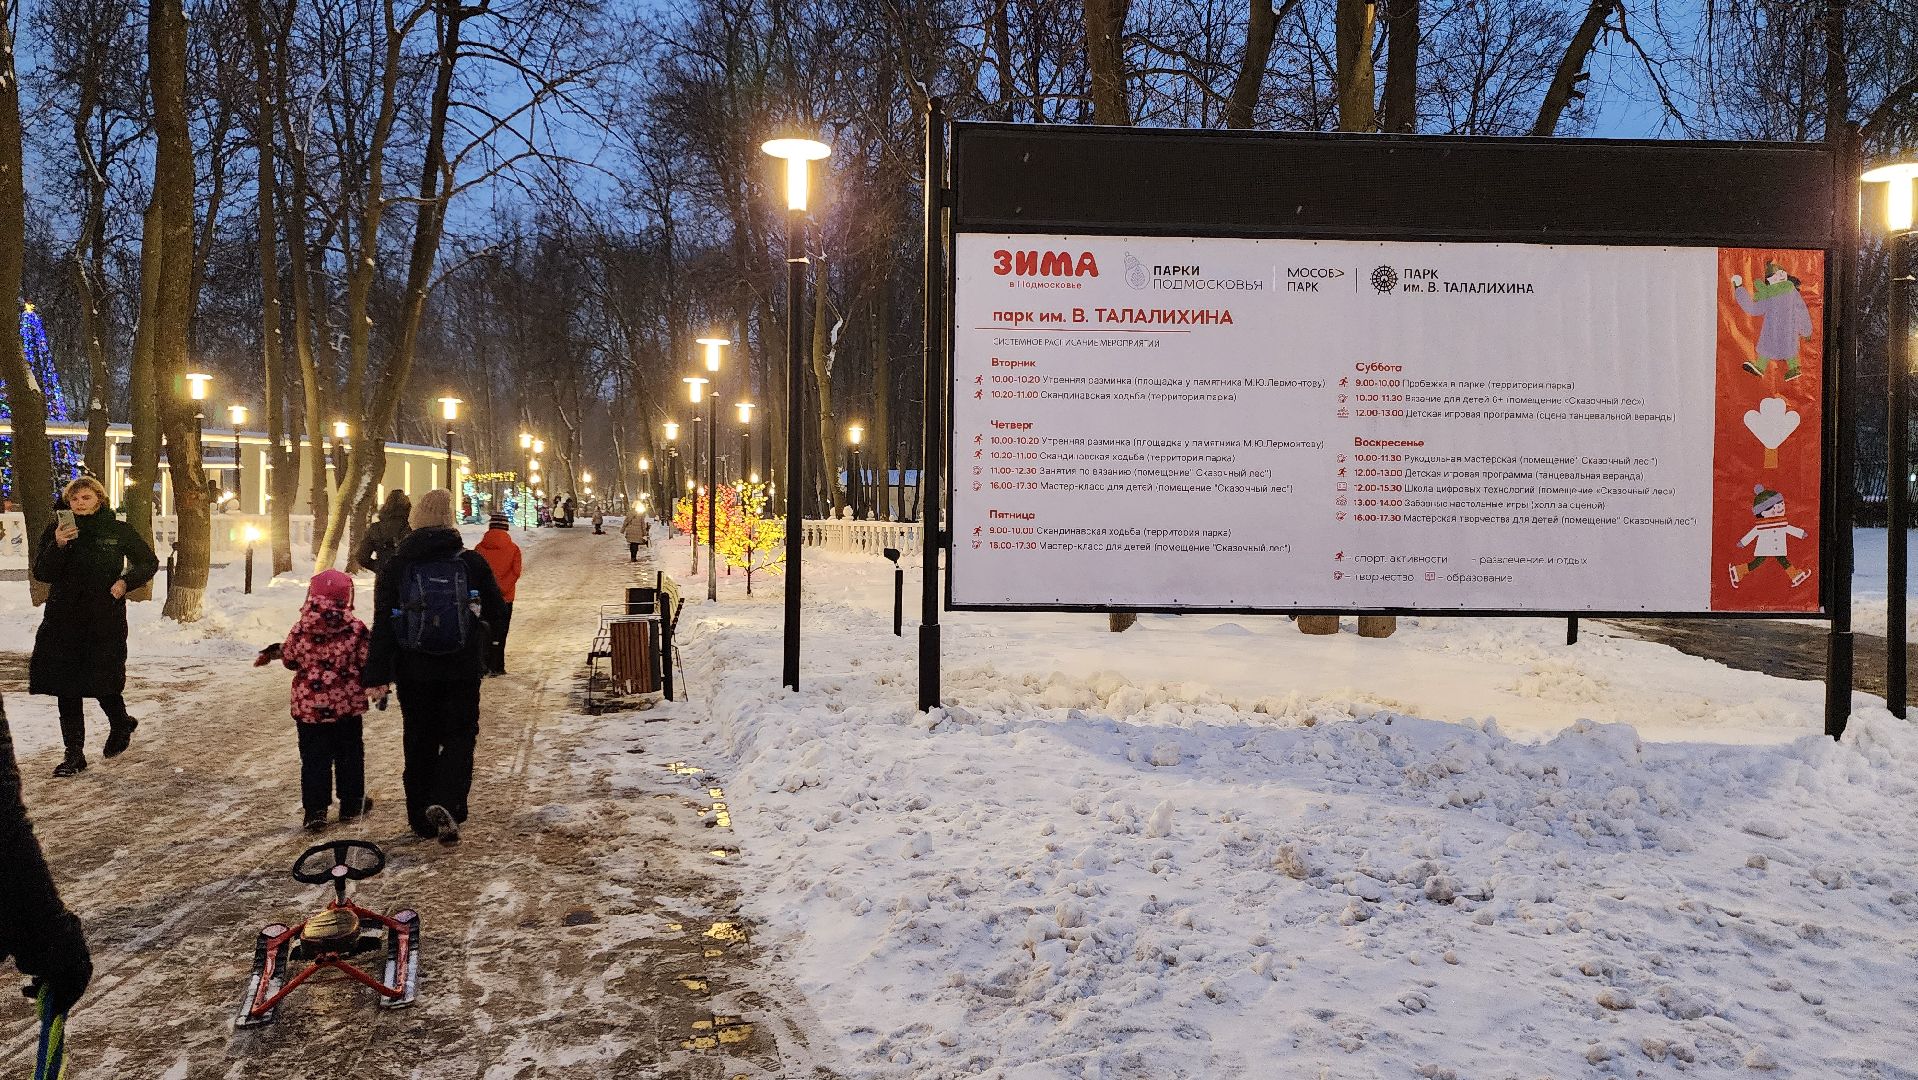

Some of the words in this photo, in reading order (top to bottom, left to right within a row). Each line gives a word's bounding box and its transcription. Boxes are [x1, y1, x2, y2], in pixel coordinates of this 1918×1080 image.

[993, 249, 1099, 277] ЗИМА
[1153, 265, 1200, 276] ПАРКИ
[1404, 269, 1438, 279] ПАРК
[1017, 281, 1082, 289] Подмосковье
[1153, 279, 1263, 291] ПОДМОСКОВЬЯ
[1287, 282, 1318, 292] ПАРК
[1404, 284, 1423, 292] им.
[1428, 283, 1439, 292] В.
[1444, 282, 1534, 294] ТАЛАЛИХИНА
[993, 311, 1034, 326] парк
[1039, 311, 1066, 322] им.
[1072, 308, 1089, 323] В.
[1095, 309, 1233, 324] ТАЛАЛИХИНА
[992, 358, 1036, 369] Вторник
[1356, 363, 1402, 373] Суббота
[1356, 379, 1400, 387] 9.00-10.00
[991, 420, 1033, 431] Четверг
[990, 510, 1035, 520] Пятница
